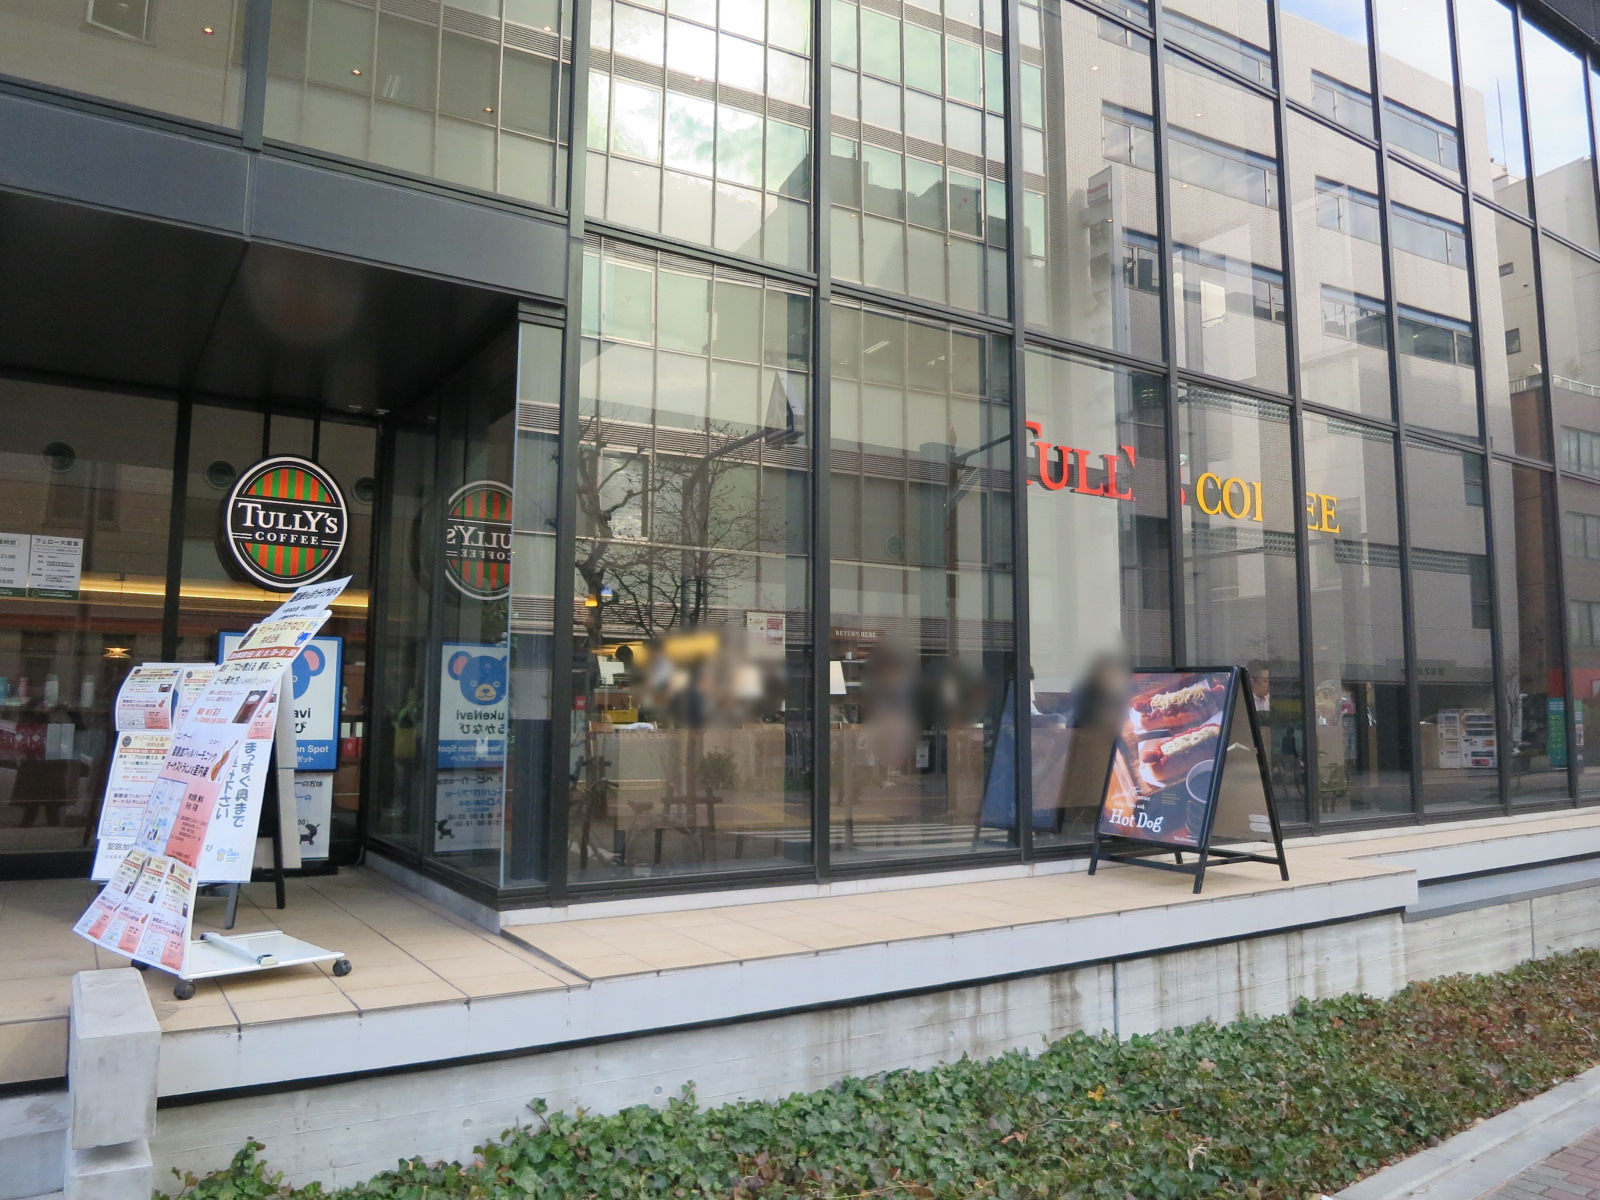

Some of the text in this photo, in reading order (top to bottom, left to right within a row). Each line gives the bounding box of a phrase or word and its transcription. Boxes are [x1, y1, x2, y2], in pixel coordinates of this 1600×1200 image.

[1196, 472, 1340, 533] COEE
[238, 502, 338, 534] TULLY'S
[255, 531, 319, 546] COFFEE
[860, 631, 877, 639] HERE
[307, 744, 329, 755] Spot
[1108, 808, 1164, 833] Hot Dog
